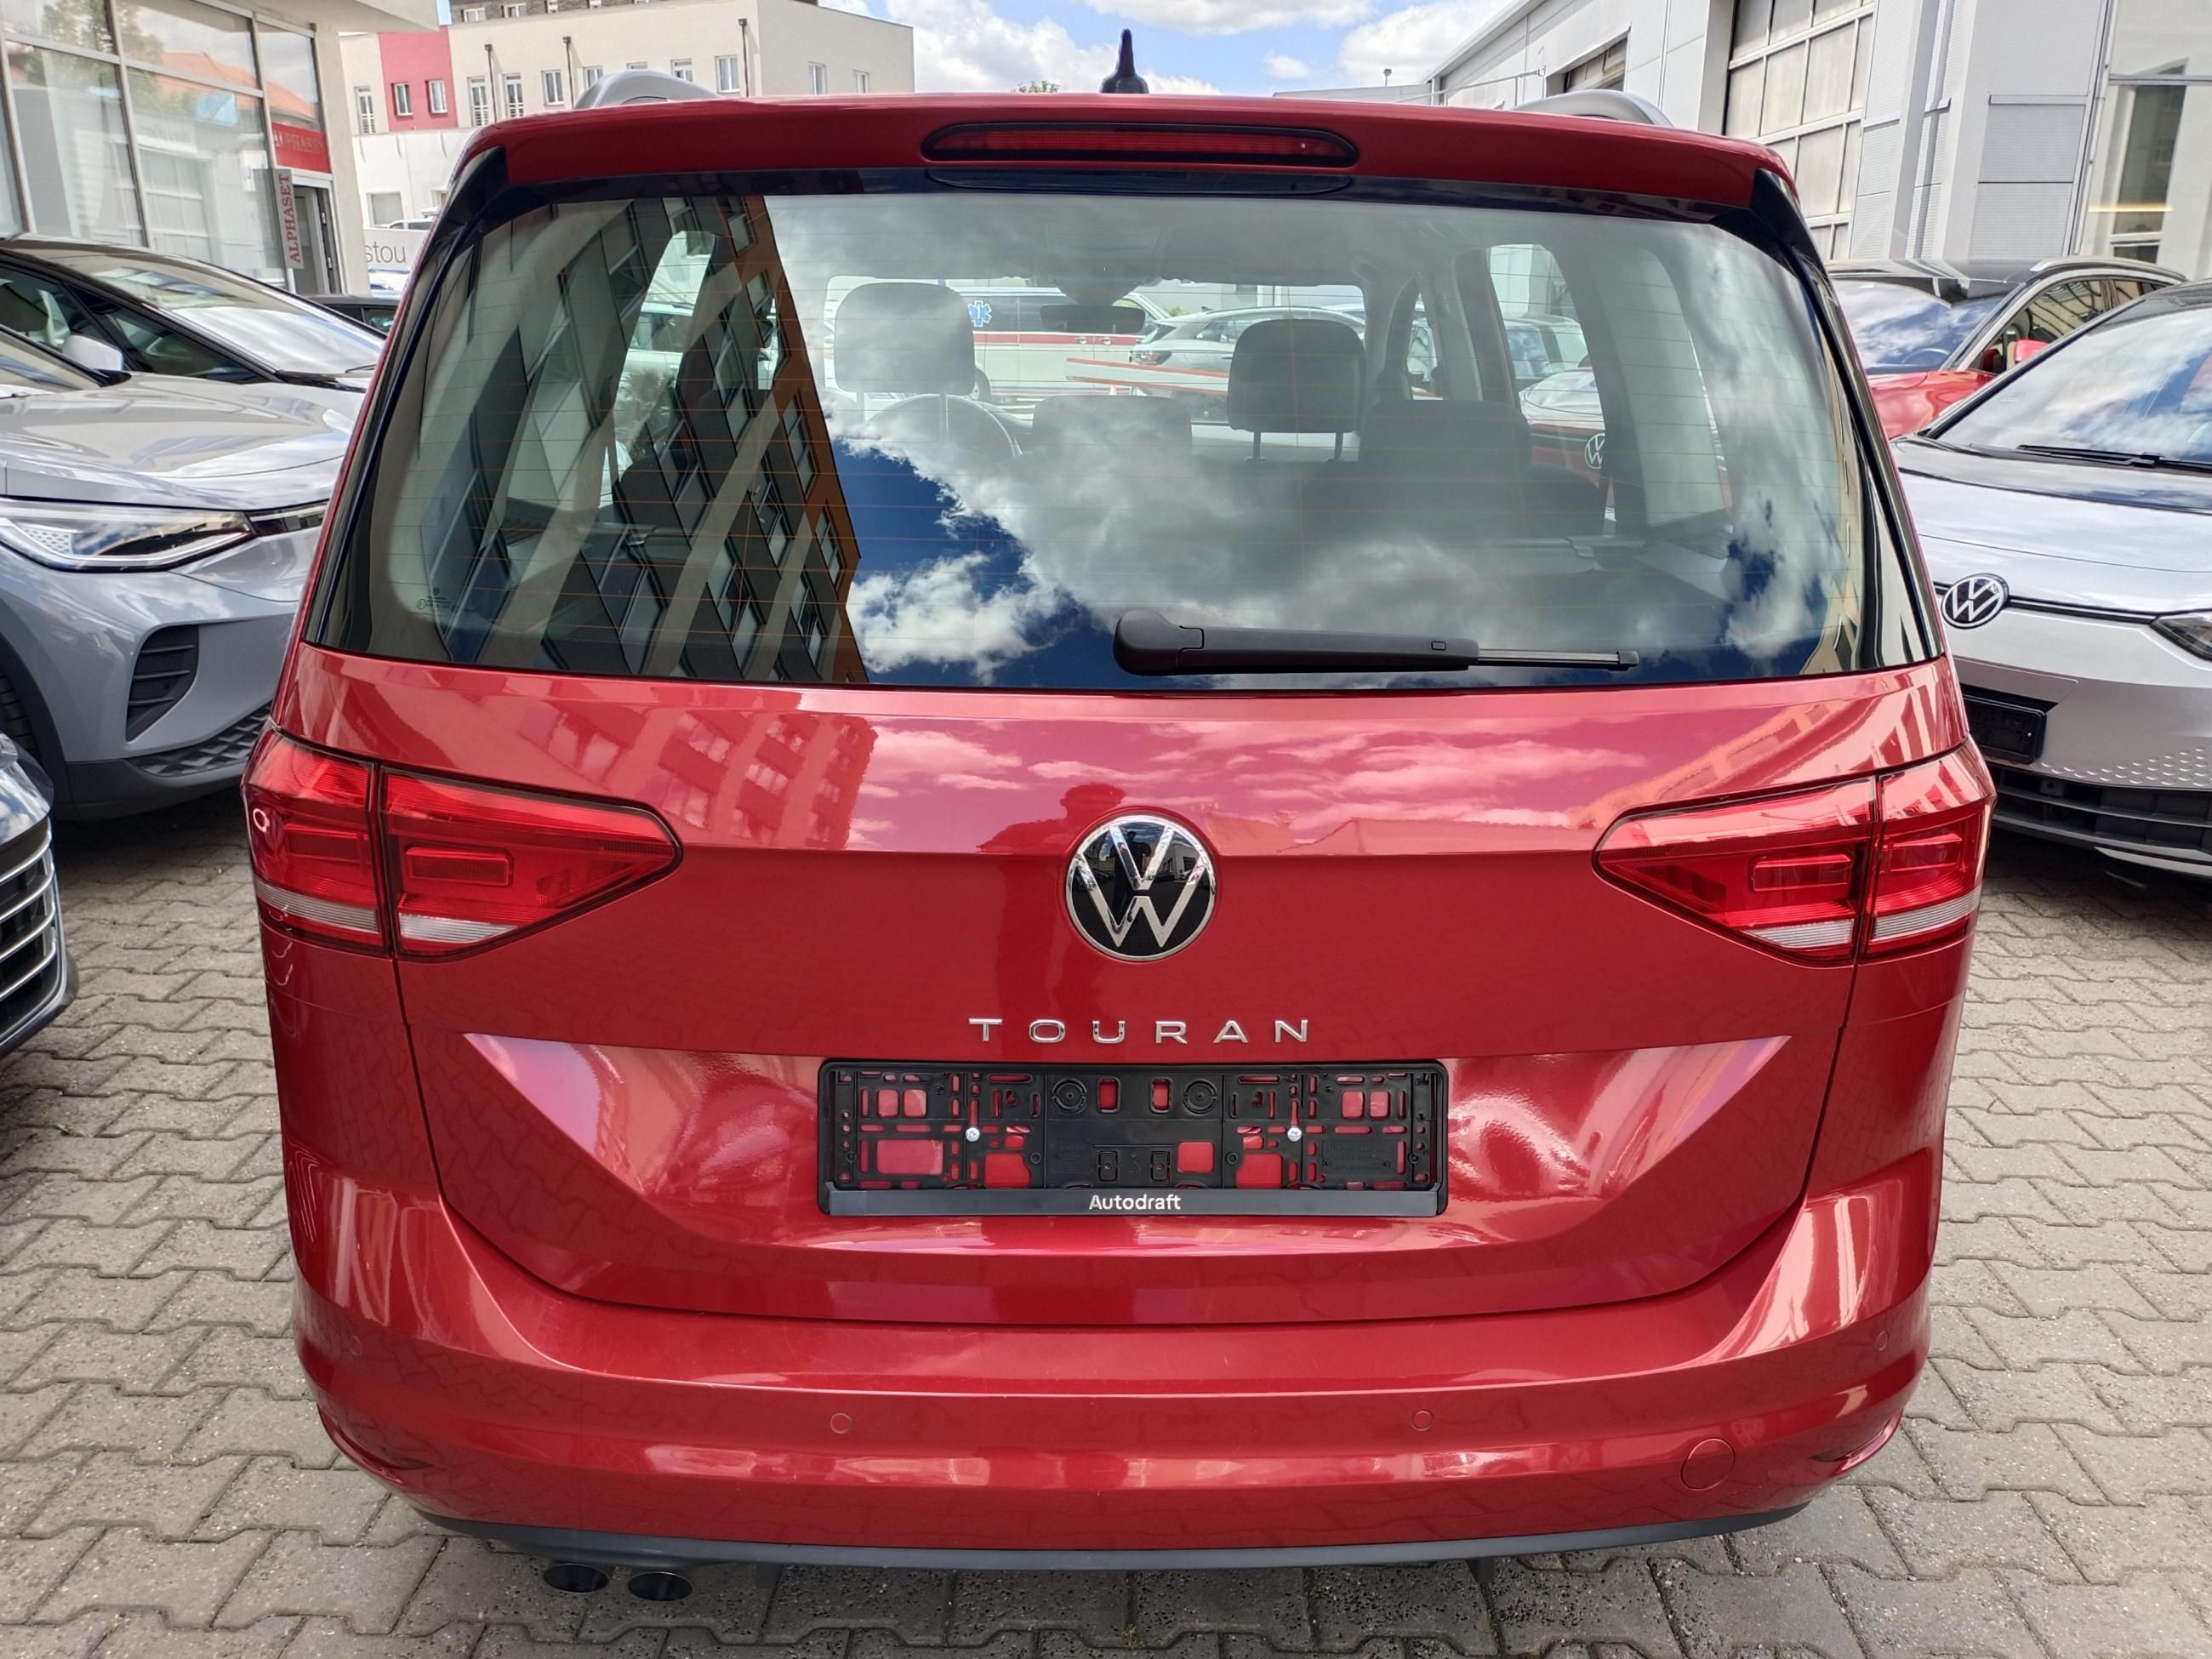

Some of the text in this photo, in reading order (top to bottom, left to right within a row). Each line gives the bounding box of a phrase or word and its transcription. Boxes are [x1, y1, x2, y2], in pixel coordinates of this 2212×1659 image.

[278, 174, 301, 264] ALPHASET
[1947, 577, 2002, 623] VW
[1074, 821, 1211, 951] VW
[968, 1017, 1309, 1044] TOURAN
[1088, 1194, 1182, 1211] Autodraft
